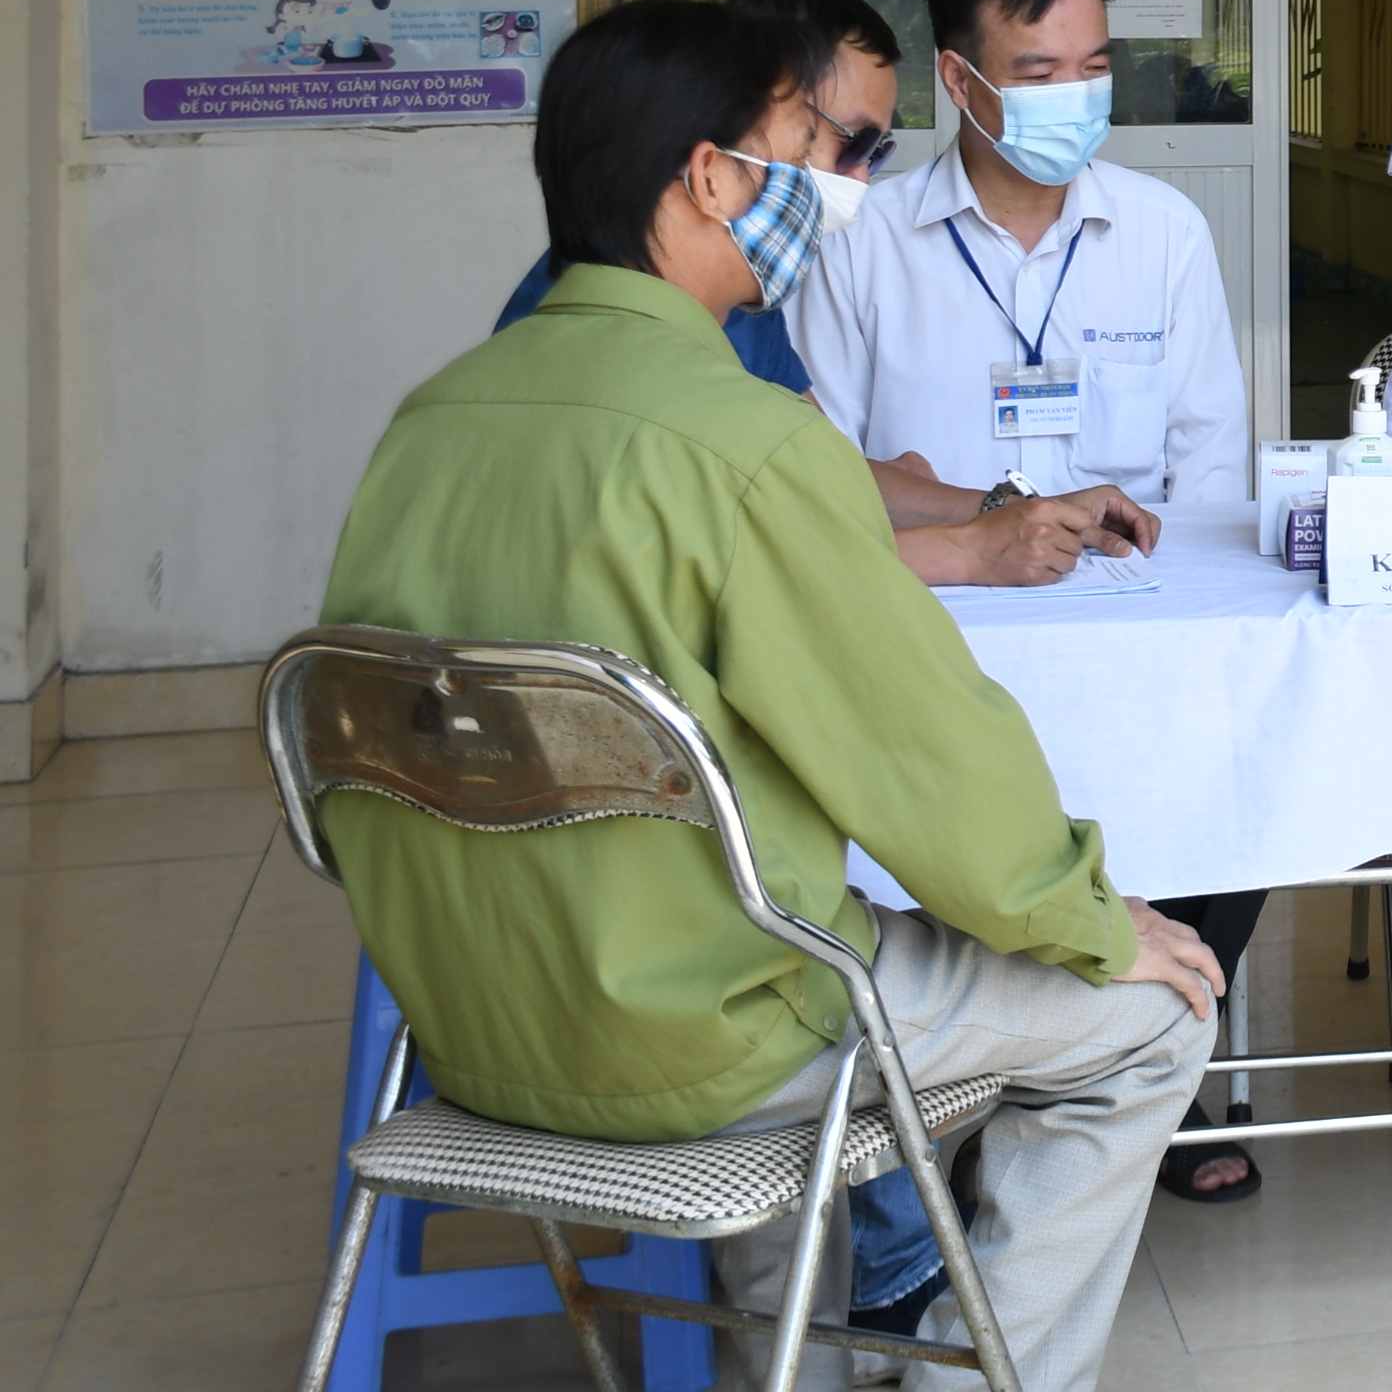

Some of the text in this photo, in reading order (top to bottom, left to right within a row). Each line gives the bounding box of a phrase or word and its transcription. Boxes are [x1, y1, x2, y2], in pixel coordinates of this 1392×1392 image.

[187, 83, 216, 97] HÃY
[269, 83, 299, 96] NHẸ
[303, 82, 333, 94] TAY,
[337, 77, 376, 92] GIẢM
[381, 79, 420, 90] NGAY
[424, 76, 446, 89] ĐỒ
[203, 101, 227, 115] DỰ
[231, 98, 285, 112] PHÒNG
[288, 96, 328, 111] TĂNG
[332, 94, 378, 108] HUYẾT
[382, 94, 401, 107] ÁP
[404, 93, 423, 106] VÀ
[427, 94, 455, 107] ĐỘT
[1271, 469, 1308, 478] Rapigen
[1295, 515, 1323, 527] LAT
